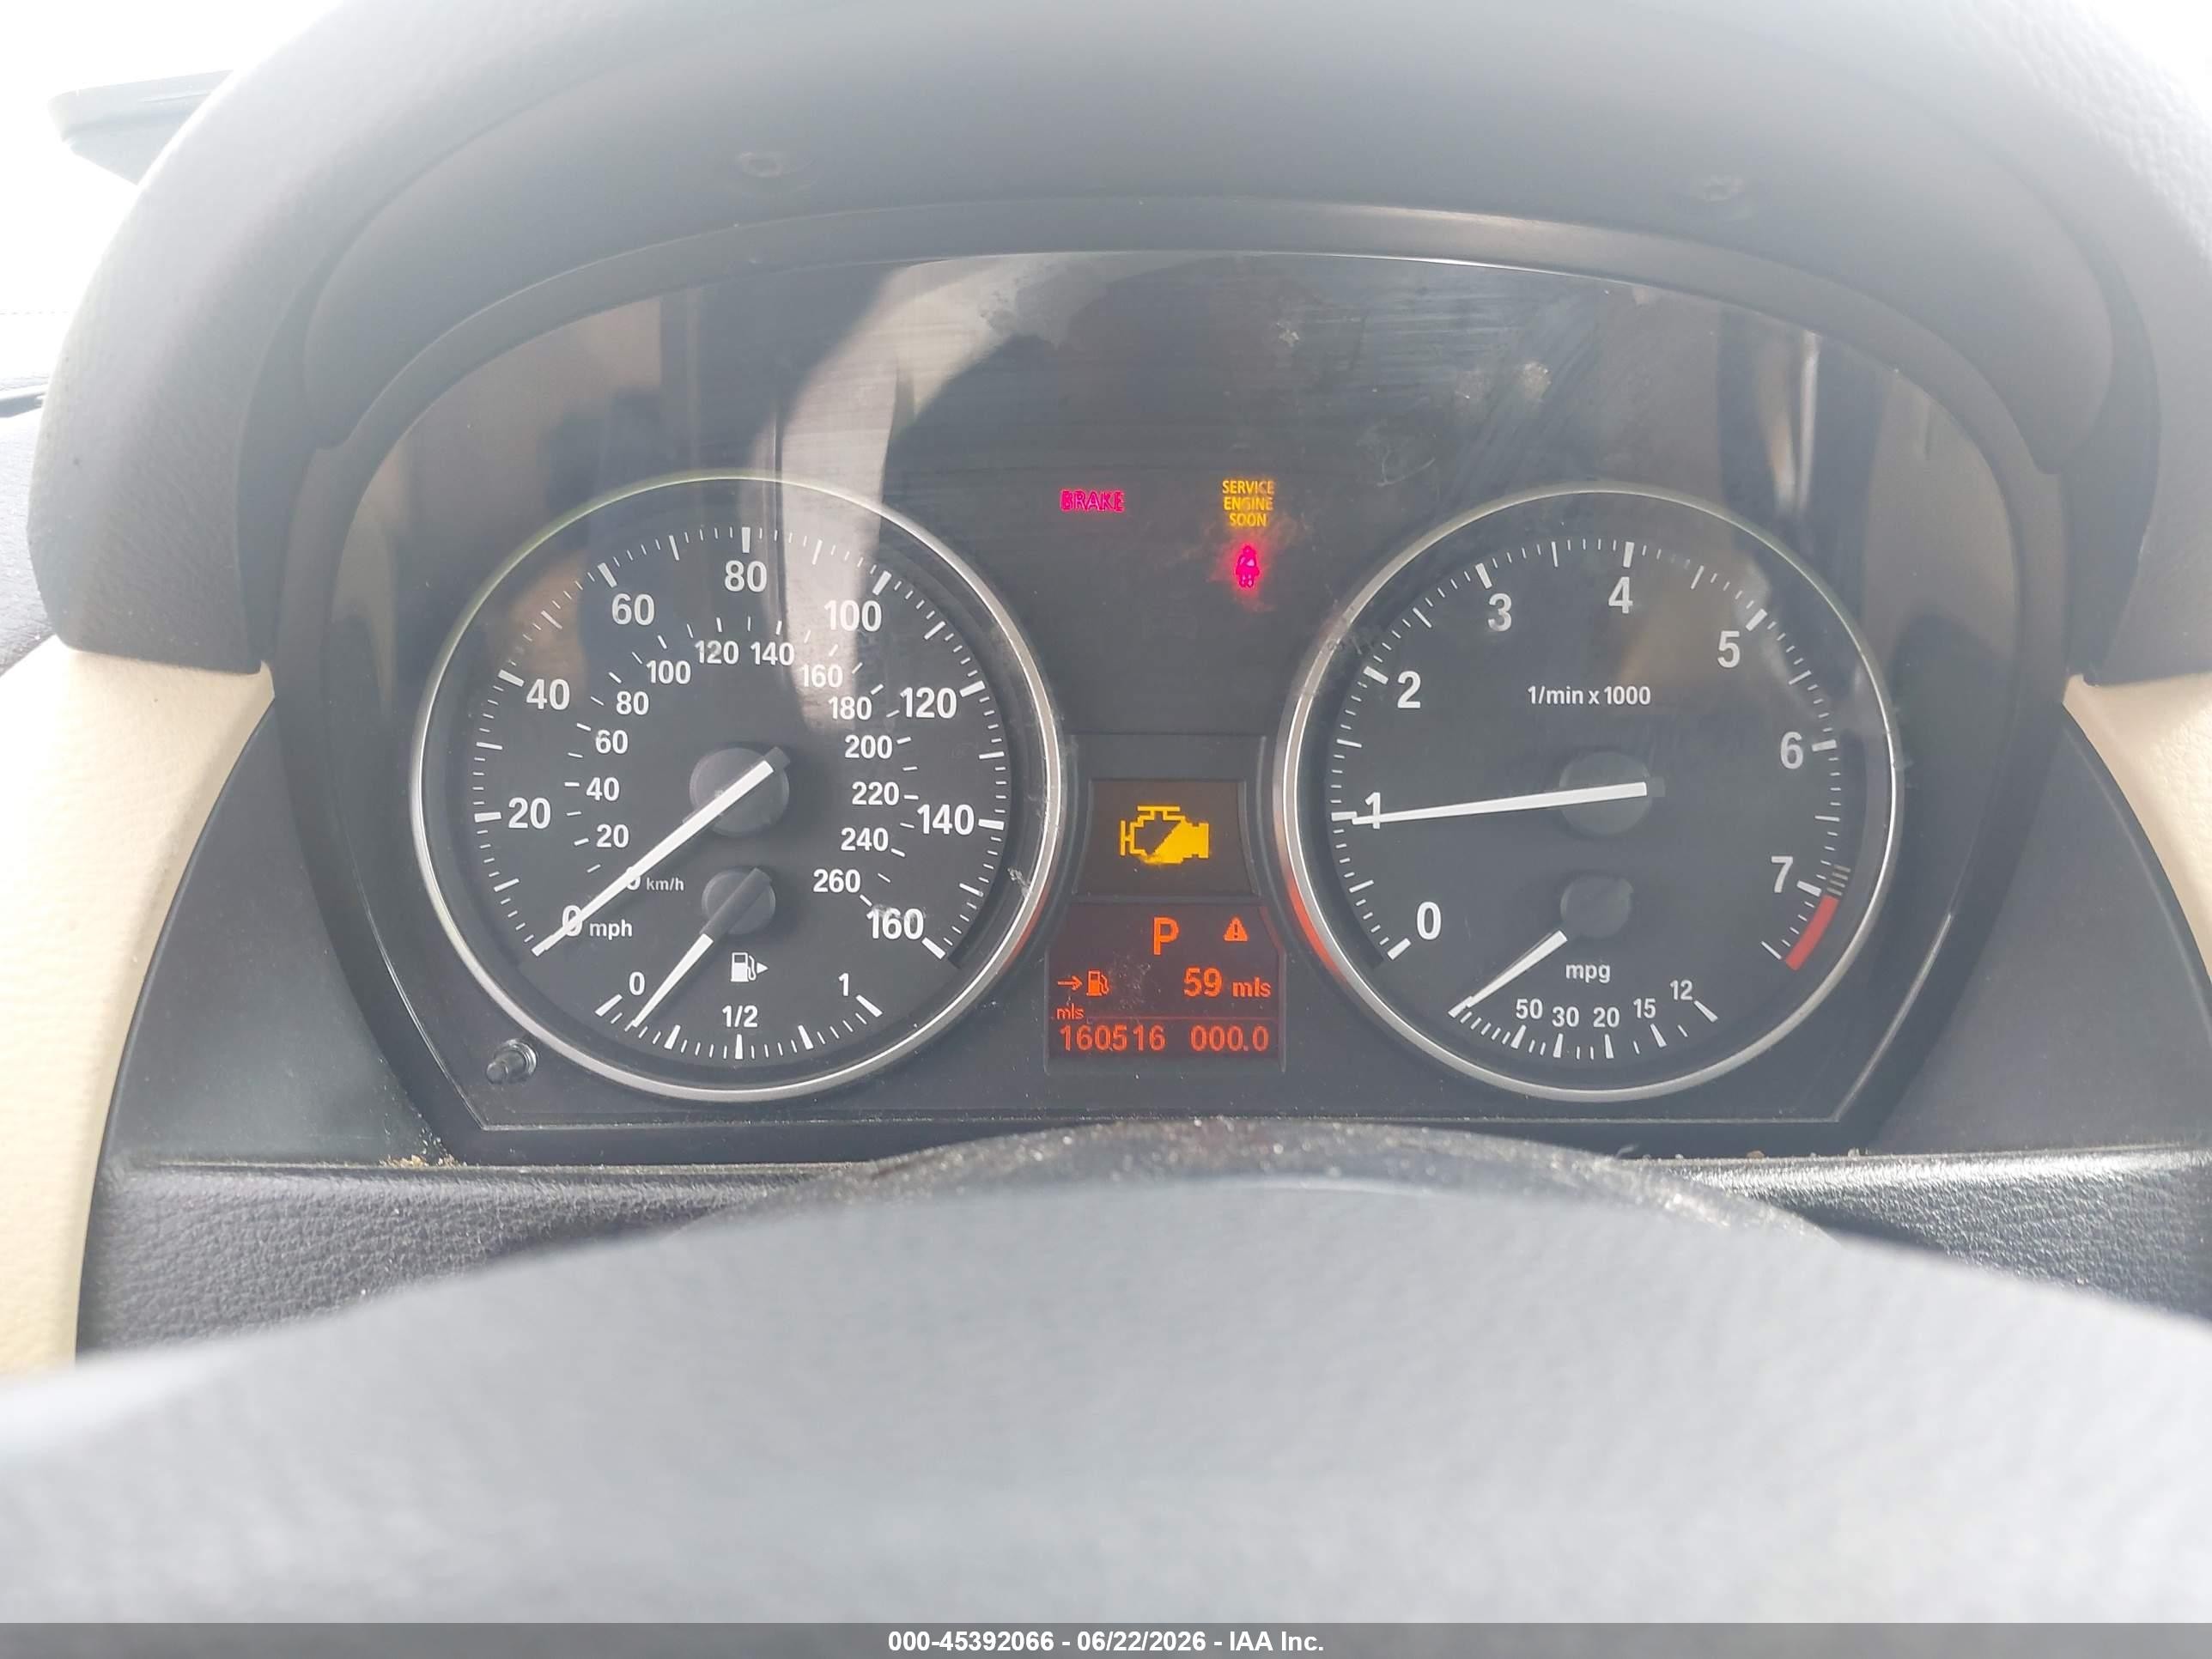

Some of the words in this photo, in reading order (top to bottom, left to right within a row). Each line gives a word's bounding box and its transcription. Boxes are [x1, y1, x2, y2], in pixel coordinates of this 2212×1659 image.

[1222, 480, 1274, 494] SERVICE
[1060, 489, 1125, 511] BRAKE
[1224, 497, 1273, 510] ENGINE
[1230, 514, 1267, 526] SOON
[724, 561, 767, 592] 80
[1609, 578, 1632, 613] 4
[611, 594, 654, 625] 60
[827, 601, 881, 631] 100
[1488, 593, 1512, 631] 3
[696, 641, 739, 665] 120
[750, 641, 794, 665] 140
[1718, 631, 1741, 667] 5
[647, 660, 690, 684] 100
[802, 664, 843, 688] 160
[526, 679, 569, 710] 40
[1398, 672, 1421, 708] 2
[1528, 686, 1583, 706] 1/min
[1589, 690, 1600, 704] x
[1603, 686, 1650, 705] 1000
[617, 692, 649, 715] 80
[829, 696, 872, 720] 180
[901, 688, 957, 718] 120
[596, 730, 628, 753] 60
[845, 735, 892, 758] 200
[1781, 732, 1803, 769] 6
[586, 778, 620, 800] 40
[852, 781, 899, 805] 220
[508, 798, 551, 829] 20
[916, 805, 975, 835] 140
[1365, 793, 1380, 829] 1
[597, 824, 629, 848] 20
[841, 828, 889, 851] 240
[647, 877, 684, 892] km/h
[813, 869, 861, 893] 260
[1771, 856, 1793, 892] 7
[562, 905, 583, 936] 0
[589, 919, 633, 939] mph
[866, 909, 924, 940] 160
[1417, 902, 1441, 940] 0
[1154, 917, 1179, 955] P
[629, 972, 645, 995] 0
[839, 973, 849, 995] 1
[1183, 967, 1223, 997] 59
[1231, 976, 1271, 998] mls
[1565, 962, 1611, 983] mpg
[1670, 981, 1692, 1000] 12
[723, 1006, 758, 1027] 1/2
[1056, 1003, 1084, 1020] mls
[1516, 1000, 1543, 1020] 50
[1553, 1007, 1579, 1027] 30
[1593, 1007, 1620, 1027] 20
[1633, 999, 1656, 1018] 15
[1060, 1024, 1166, 1052] 160516
[1190, 1024, 1268, 1052] 000.0
